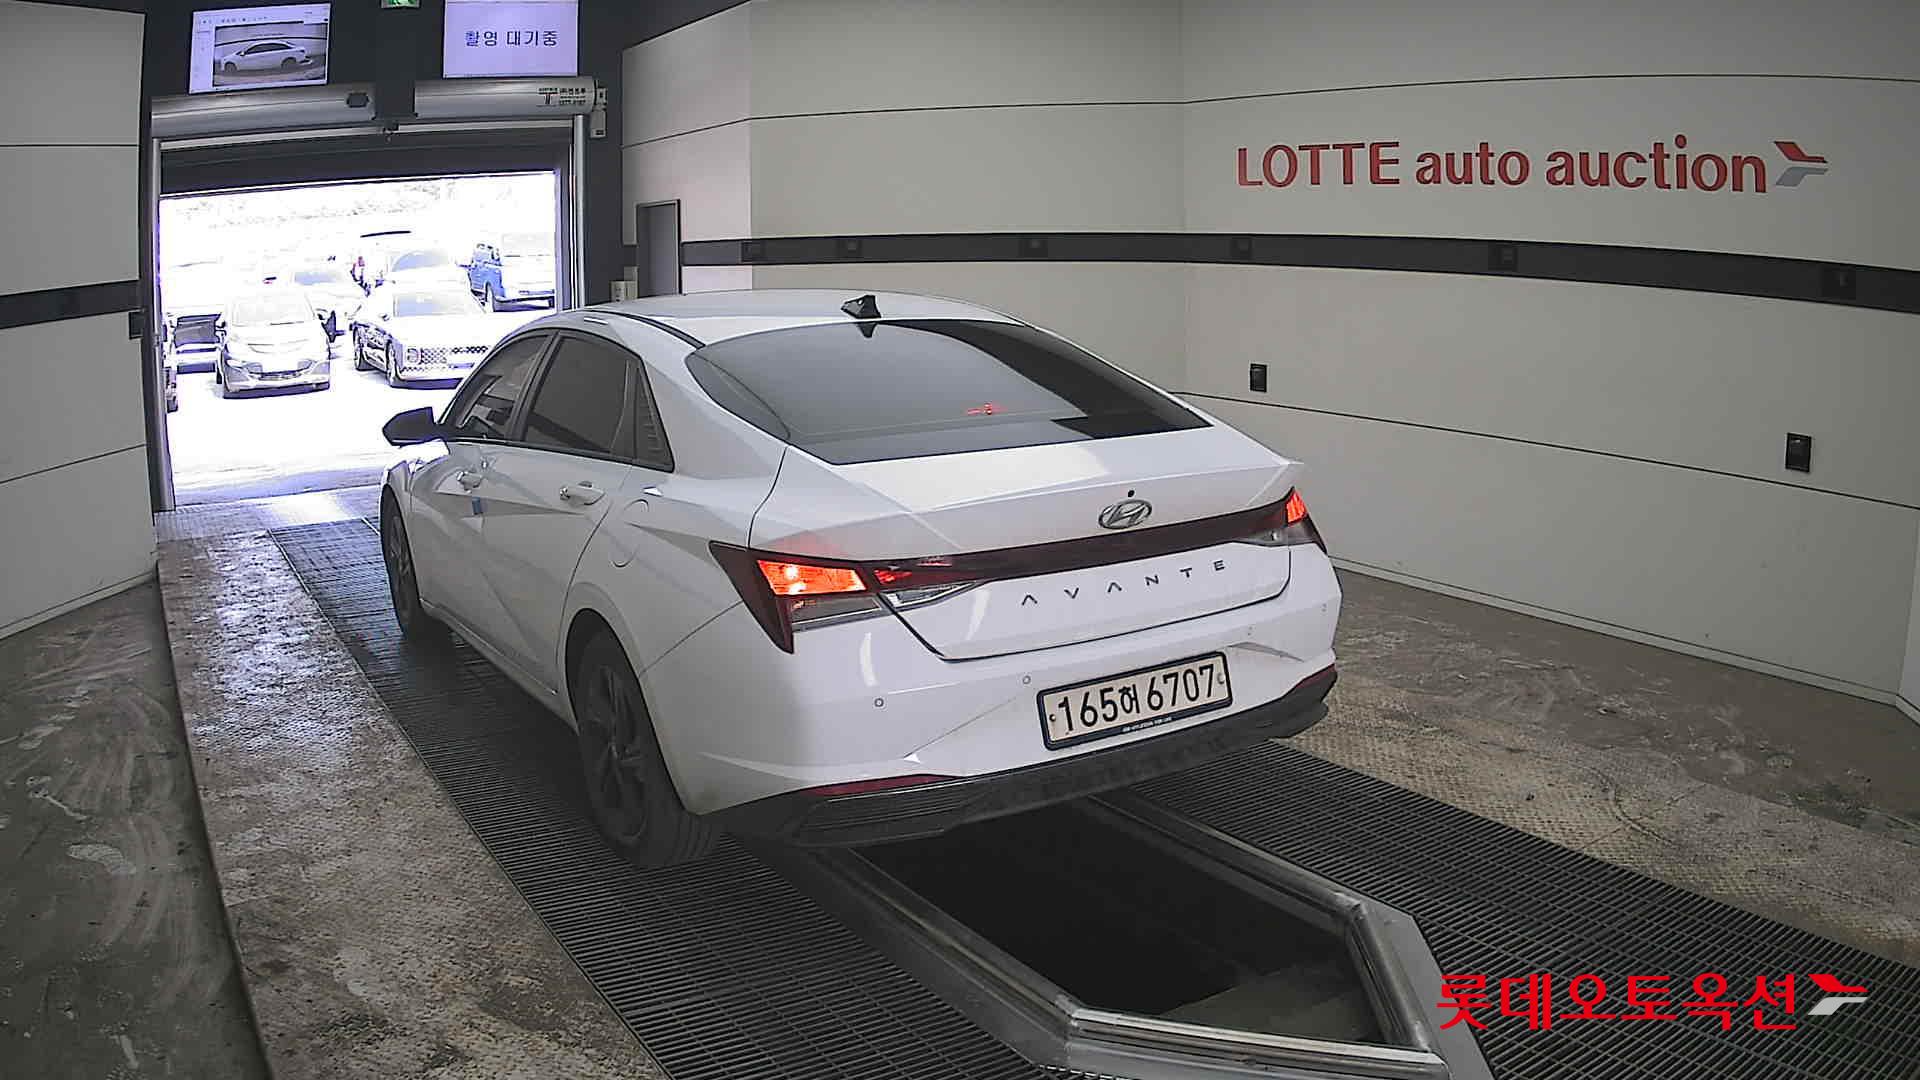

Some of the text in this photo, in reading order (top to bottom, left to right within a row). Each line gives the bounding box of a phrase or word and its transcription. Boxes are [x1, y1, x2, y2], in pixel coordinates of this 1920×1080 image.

[506, 30, 559, 47] 대기중
[1236, 134, 1767, 194] LOTTE auto auction
[1021, 559, 1225, 606] AVANTE
